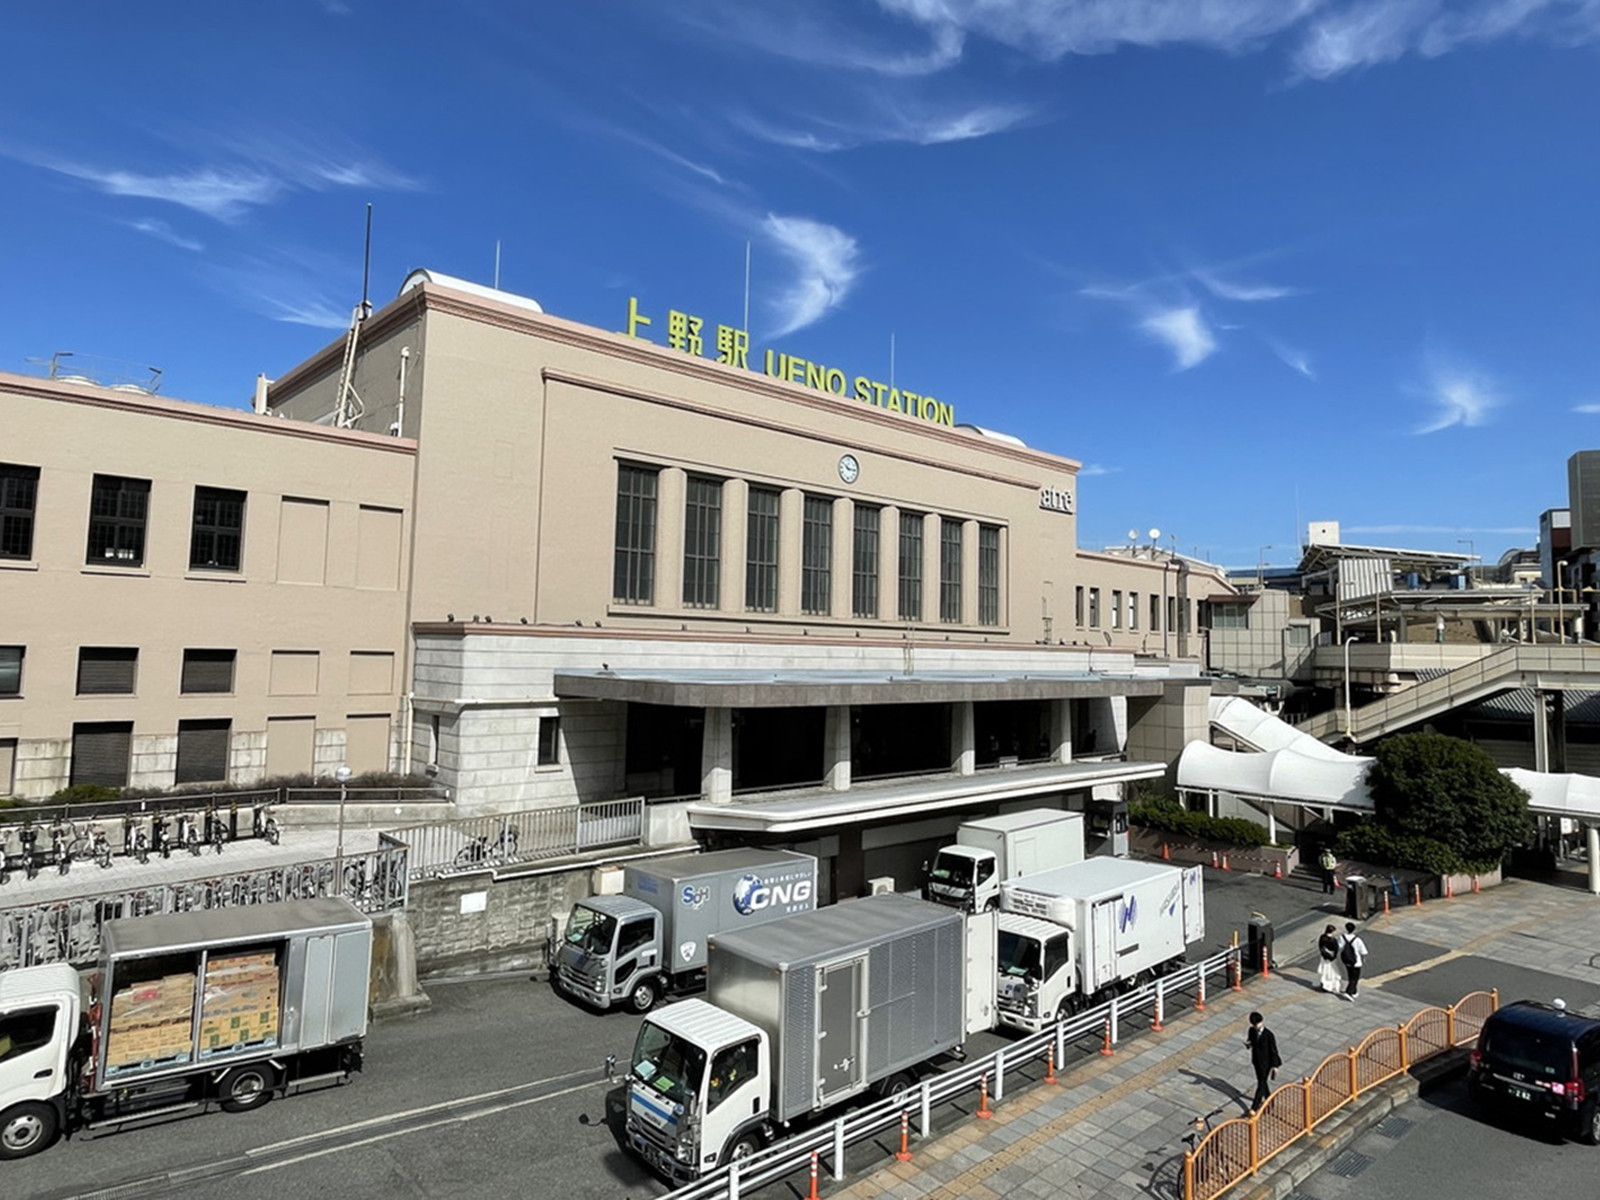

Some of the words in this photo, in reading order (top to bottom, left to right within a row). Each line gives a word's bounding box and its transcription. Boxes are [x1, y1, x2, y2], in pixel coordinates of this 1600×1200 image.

[616, 296, 749, 371] 上野駅
[764, 349, 847, 397] UENO
[853, 376, 954, 428] STATION
[749, 880, 812, 911] CNG
